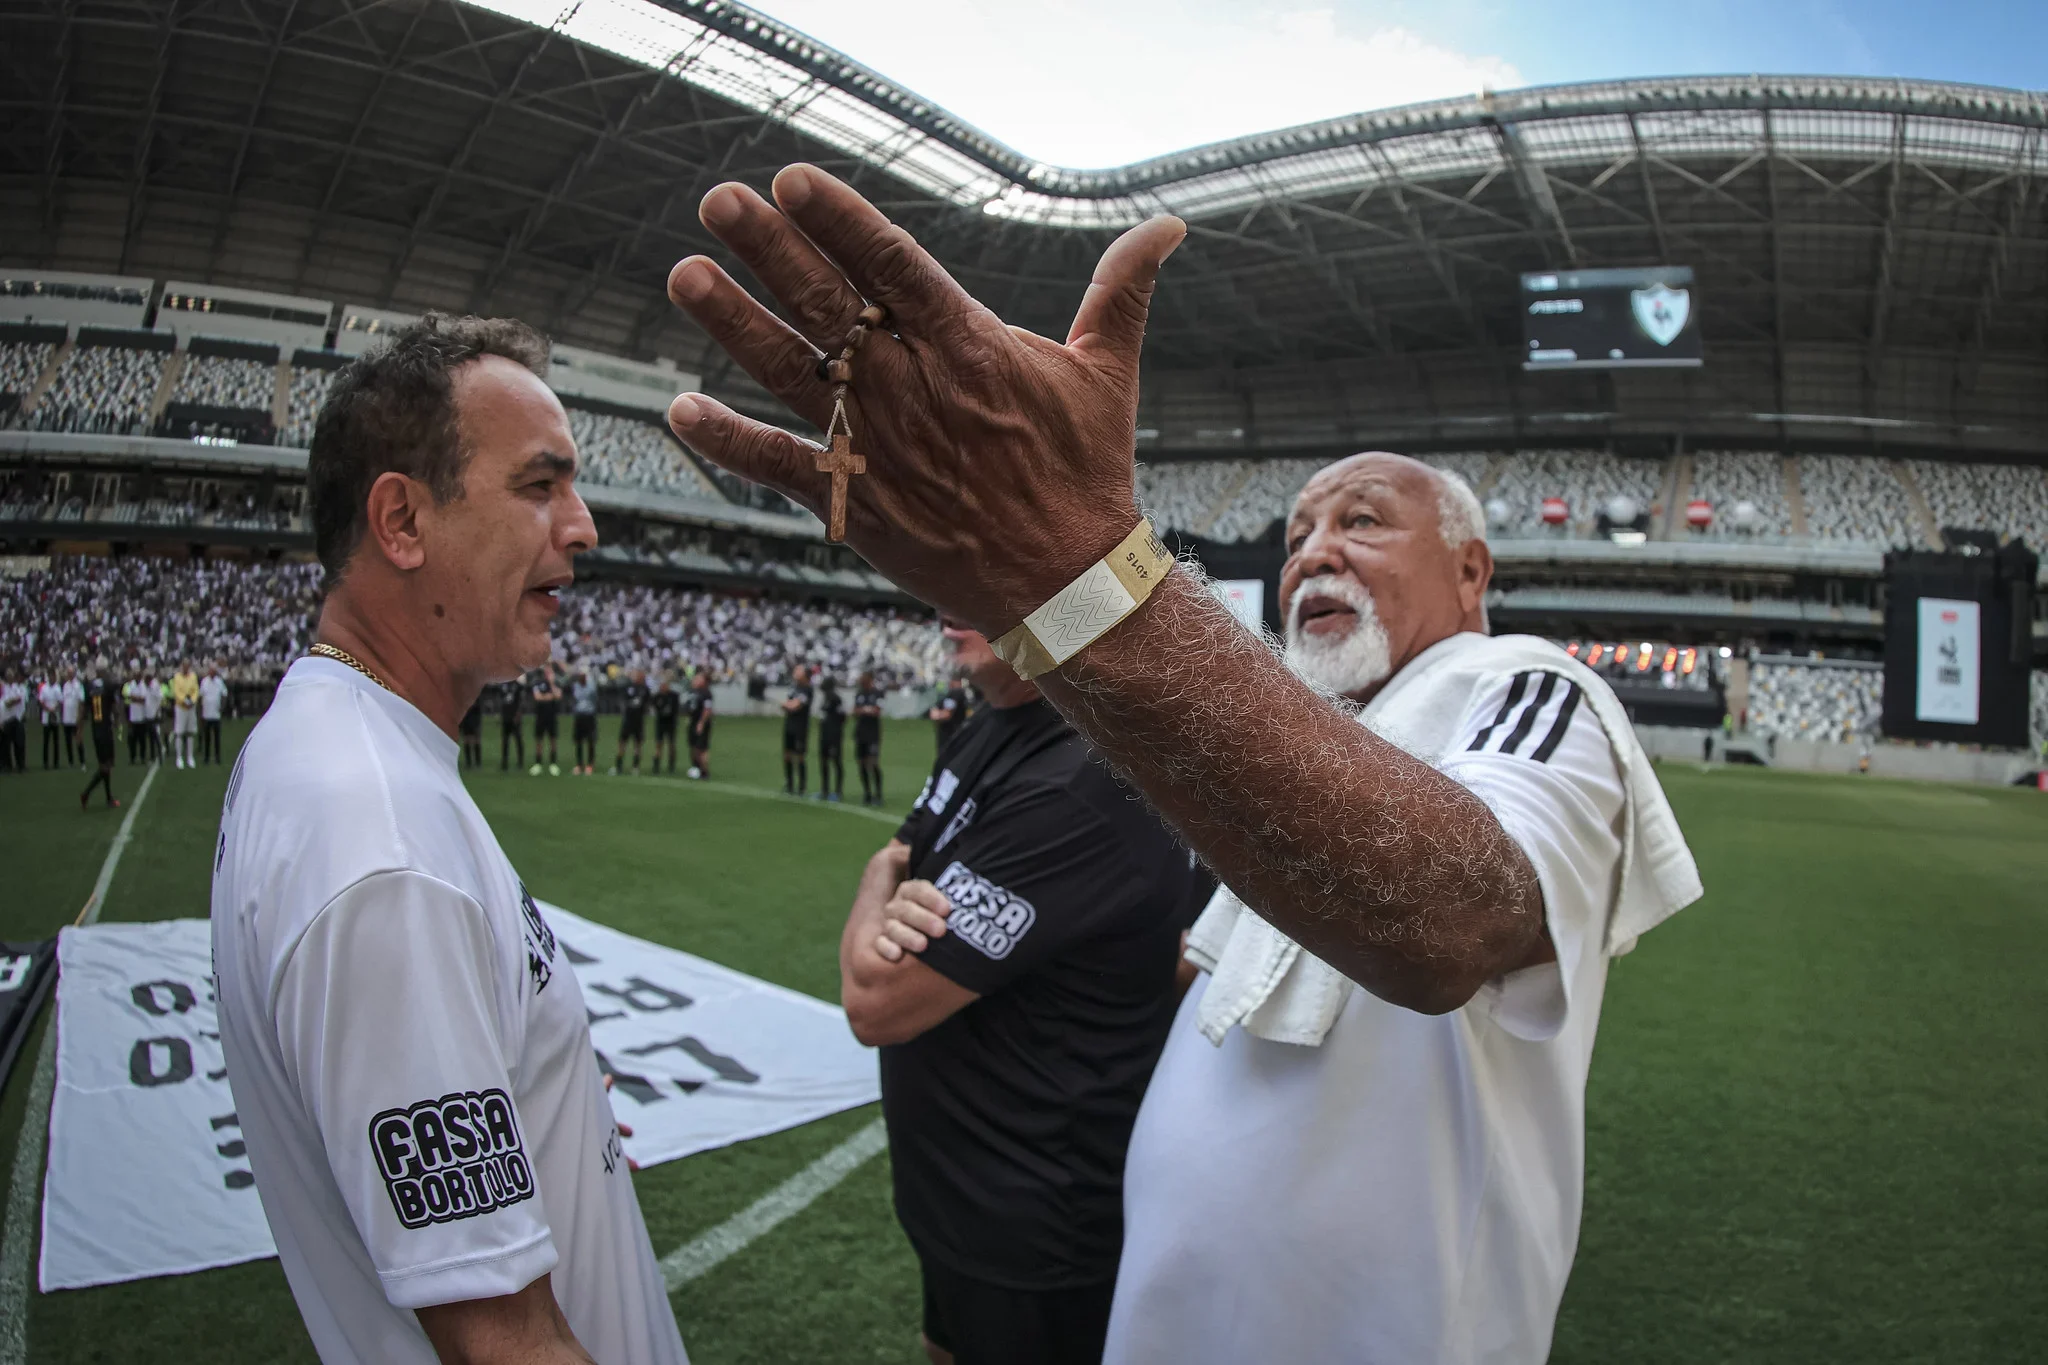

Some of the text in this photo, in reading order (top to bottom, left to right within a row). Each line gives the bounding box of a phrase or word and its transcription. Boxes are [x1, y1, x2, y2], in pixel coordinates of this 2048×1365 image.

[1126, 552, 1148, 579] 4015
[936, 865, 1030, 935] FASSA
[375, 1096, 518, 1177] FASSA
[393, 1152, 530, 1222] BORTOLO
